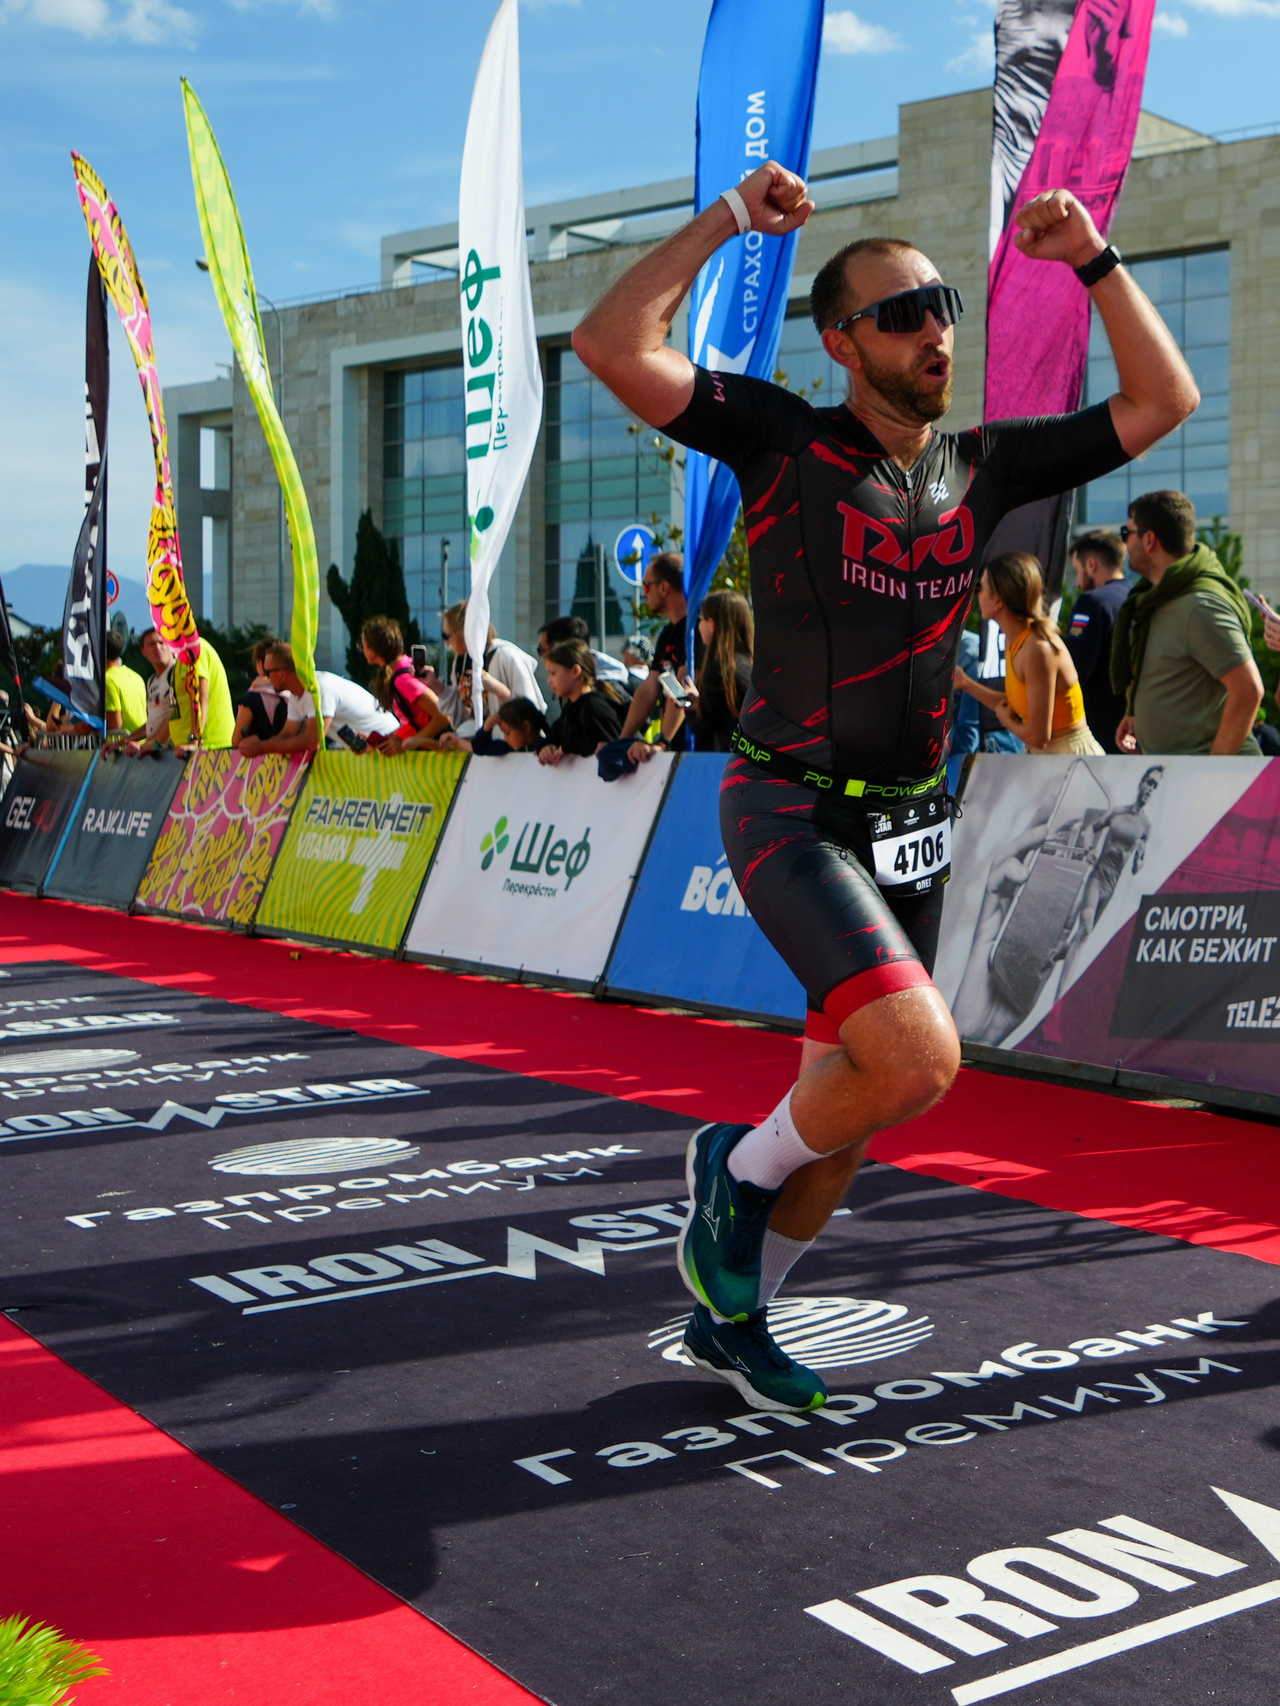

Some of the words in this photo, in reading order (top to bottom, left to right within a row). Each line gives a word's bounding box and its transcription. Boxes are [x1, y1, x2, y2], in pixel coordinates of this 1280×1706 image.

[745, 90, 770, 159] ДОМ
[461, 248, 501, 460] Шеф
[842, 558, 907, 600] IRON
[916, 568, 975, 600] TEAM
[6, 796, 36, 830] GEL
[304, 795, 434, 836] FAHRENHEIT
[296, 831, 348, 862] VITAMIN
[510, 822, 591, 892] Шеф
[893, 830, 944, 876] 4706
[916, 877, 933, 891] ОЛЕГ
[1144, 905, 1248, 934] СМОТРИ,
[1136, 938, 1186, 963] КАК
[1188, 937, 1278, 963] БЕЖИТ
[5, 1011, 175, 1032] STAR
[0, 1052, 312, 1089] ромбанк
[214, 1078, 421, 1109] STAR
[66, 1143, 642, 1229] Газпромбанк
[202, 1165, 604, 1231] Премиум
[190, 1238, 487, 1304] IRON
[568, 1200, 697, 1240] ST
[512, 1310, 1250, 1486] Газпромбанк
[725, 1356, 1243, 1490] Премиум
[804, 1514, 1248, 1675] IRON
